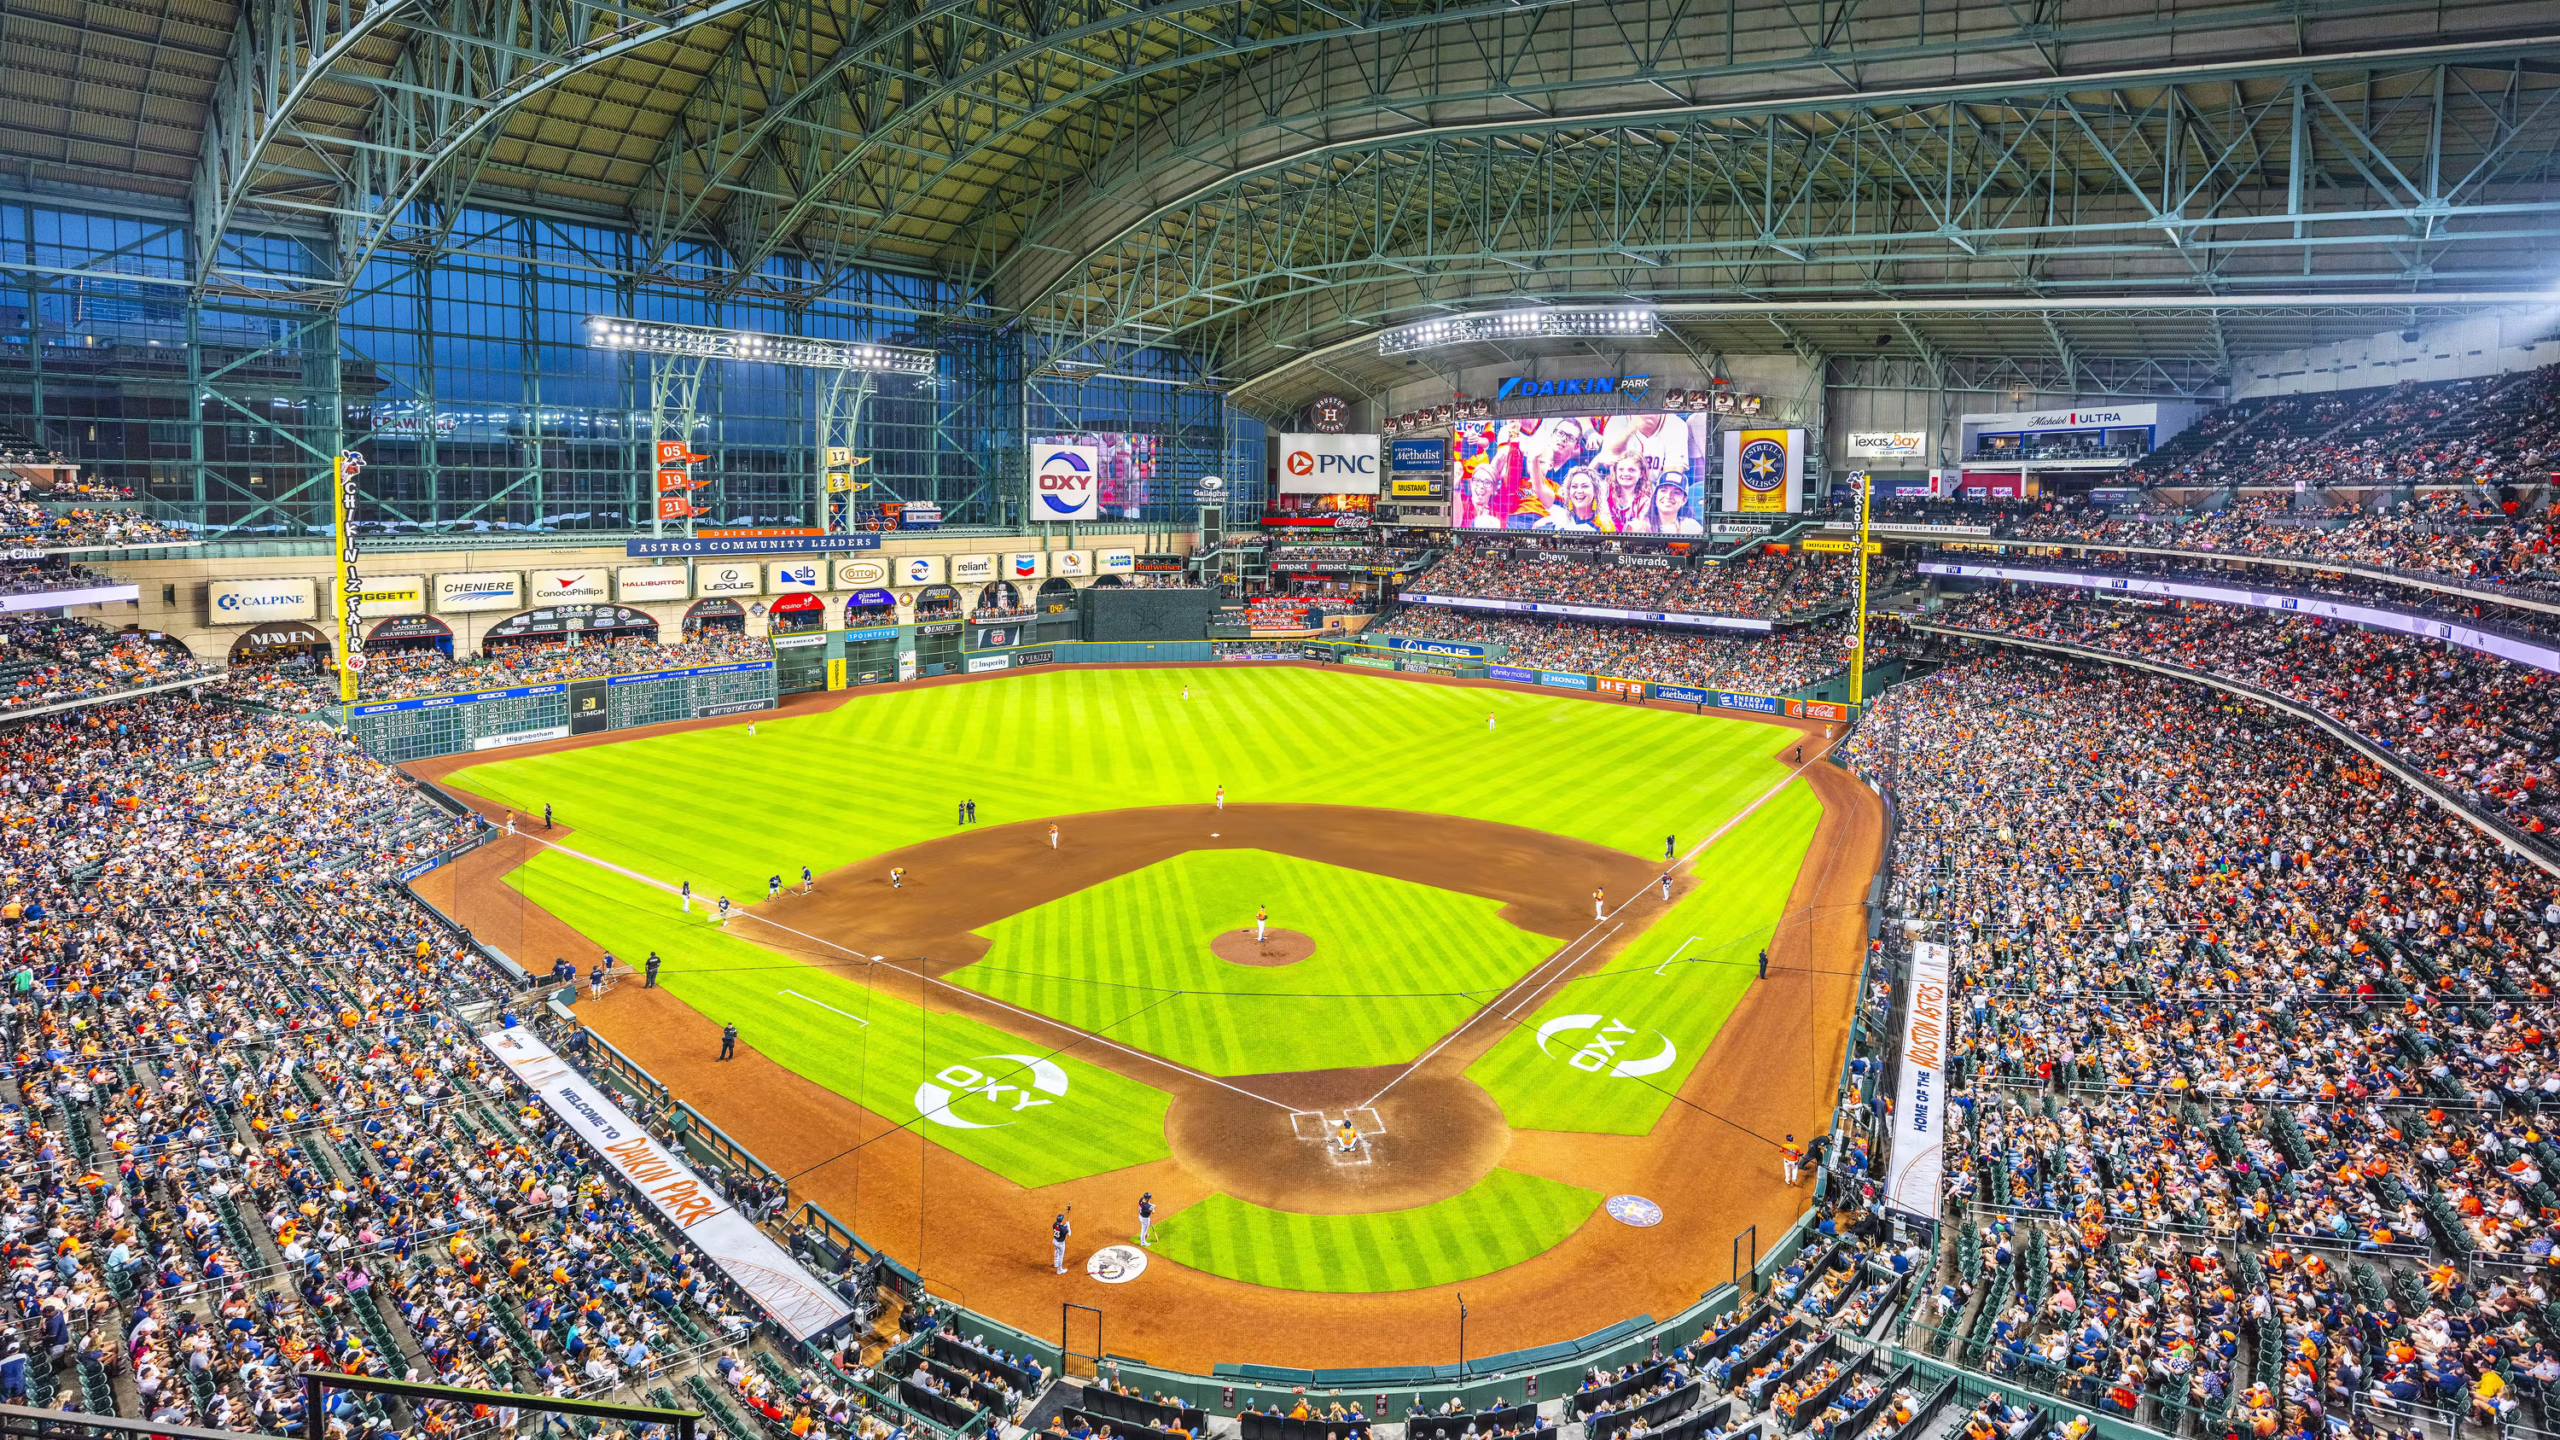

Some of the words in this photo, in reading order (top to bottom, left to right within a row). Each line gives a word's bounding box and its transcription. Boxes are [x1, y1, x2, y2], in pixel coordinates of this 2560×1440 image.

[1521, 377, 1616, 397] DAIKIN
[1621, 378, 1649, 389] PARK
[1316, 398, 1346, 408] HOUSTON
[1720, 392, 1728, 404] 5
[1324, 409, 1337, 421] H
[1400, 414, 1412, 424] 40
[1419, 410, 1430, 419] 25
[2028, 415, 2068, 427] Michelob
[2080, 413, 2121, 424] ULTRA
[1317, 422, 1344, 431] ASTROS
[1853, 435, 1888, 446] Texas
[1894, 434, 1920, 449] Bay
[664, 446, 680, 457] 05
[832, 452, 845, 461] 17
[1395, 450, 1440, 460] Methodist
[1745, 444, 1782, 460] ESTRELLA
[1318, 455, 1374, 474] PNC
[666, 475, 681, 486] 19
[833, 478, 845, 487] 22
[1039, 475, 1092, 490] OXY
[1746, 476, 1780, 488] JALISCO
[666, 502, 680, 512] 21
[1854, 494, 1863, 532] ROOT
[344, 482, 358, 563] CHIKIN
[640, 542, 702, 552] ASTROS
[710, 539, 804, 551] COMMUNITY
[811, 538, 871, 548] LEADERS
[1852, 535, 1860, 545] 4
[10, 548, 46, 560] Club
[1539, 552, 1569, 564] Chevy
[1618, 556, 1668, 567] Silverado
[958, 562, 987, 571] reliant
[1278, 563, 1307, 571] impact
[1851, 547, 1862, 576] THA
[795, 566, 815, 579] slb
[846, 568, 877, 579] COTTON
[344, 566, 362, 593] IZ
[622, 579, 684, 588] HALLIBURTON
[444, 582, 514, 592] CHENIERE
[705, 581, 754, 591] LEXUS
[537, 587, 604, 598] ConocoPhillips
[859, 592, 880, 600] planet
[242, 595, 304, 606] CALPINE
[1850, 579, 1860, 634] CHIKIN
[346, 595, 363, 653] FAIR
[250, 630, 315, 646] MAVEN
[849, 630, 895, 639] 1POINTFIVE
[1419, 644, 1470, 656] LEXUS
[979, 659, 1006, 668] Insperity
[1404, 664, 1418, 672] SPACE
[1418, 665, 1428, 674] CITY
[1492, 668, 1510, 677] xfinity
[1512, 671, 1531, 680] mobile
[1551, 676, 1586, 686] HONDA
[529, 686, 557, 694] GEICO
[1600, 680, 1641, 694] H-E-B
[478, 692, 507, 700] GEICO
[1659, 690, 1702, 702] Methodist
[1734, 695, 1766, 704] ENERGY
[423, 698, 454, 706] GEICO
[1734, 702, 1774, 711] TRANSFER
[325, 710, 342, 718] 315
[364, 705, 398, 713] GEICO
[573, 709, 605, 718] BETMGM
[506, 731, 554, 742] Higginbotham
[1912, 984, 1944, 1025] ASTROS
[1568, 1018, 1636, 1072] OXY
[1905, 1020, 1944, 1070] HOUSTON
[1918, 1070, 1930, 1085] THE
[936, 1065, 1054, 1112] OXY
[1917, 1086, 1929, 1103] OF
[559, 1086, 607, 1129] WELCOME
[599, 1123, 621, 1140] TO
[1914, 1104, 1928, 1133] HOME
[604, 1137, 680, 1184] DAIKIN
[651, 1180, 720, 1227] PARK
